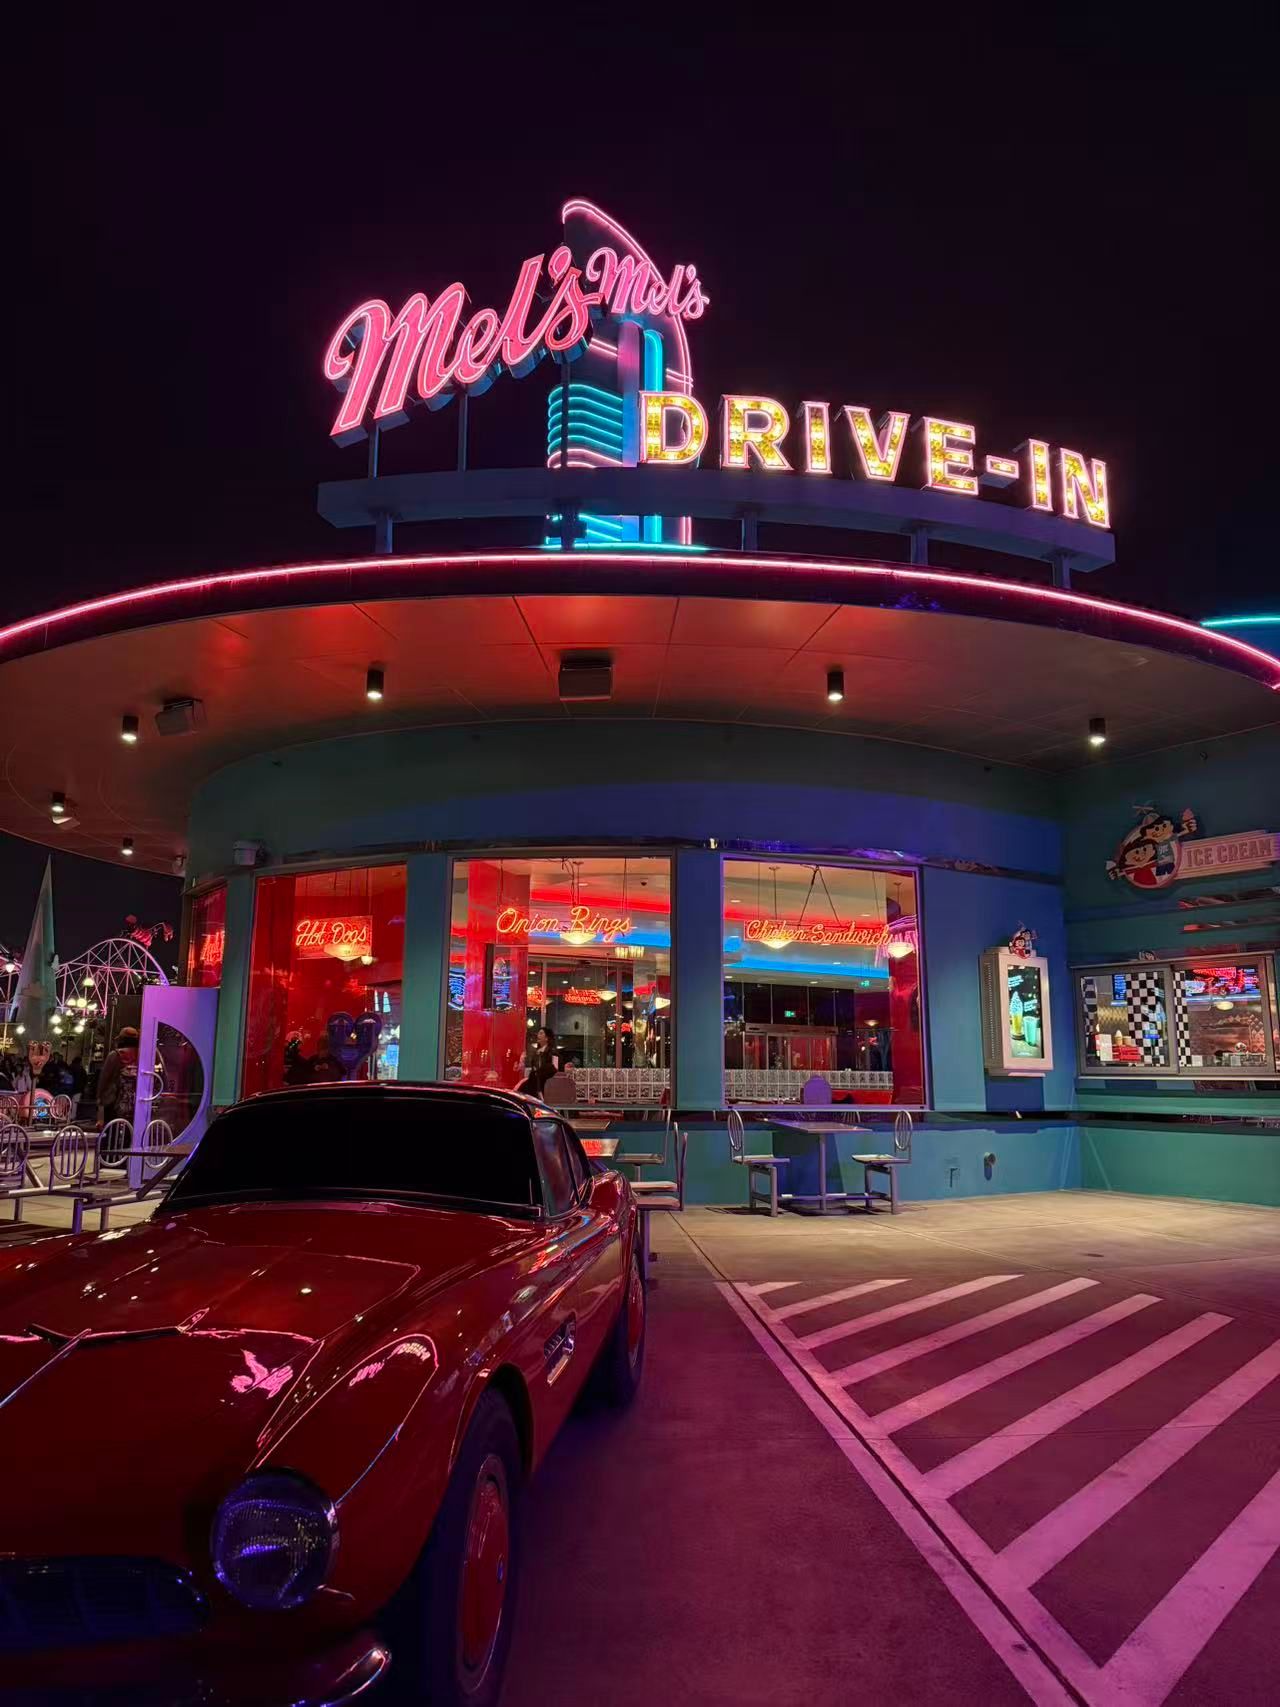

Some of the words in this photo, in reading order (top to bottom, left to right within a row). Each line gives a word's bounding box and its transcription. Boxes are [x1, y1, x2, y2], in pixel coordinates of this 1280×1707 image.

[586, 246, 711, 320] Mel's
[324, 245, 606, 437] Mel's
[638, 390, 1111, 529] DRIVE-IN
[1186, 847, 1214, 868] ICE
[1216, 838, 1273, 864] CREAM
[296, 920, 332, 946] Hot
[332, 921, 368, 949] Dogs
[496, 907, 560, 934] Onion
[570, 906, 633, 943] Rings
[746, 919, 806, 942] Chicken
[811, 921, 894, 946] Sandwich
